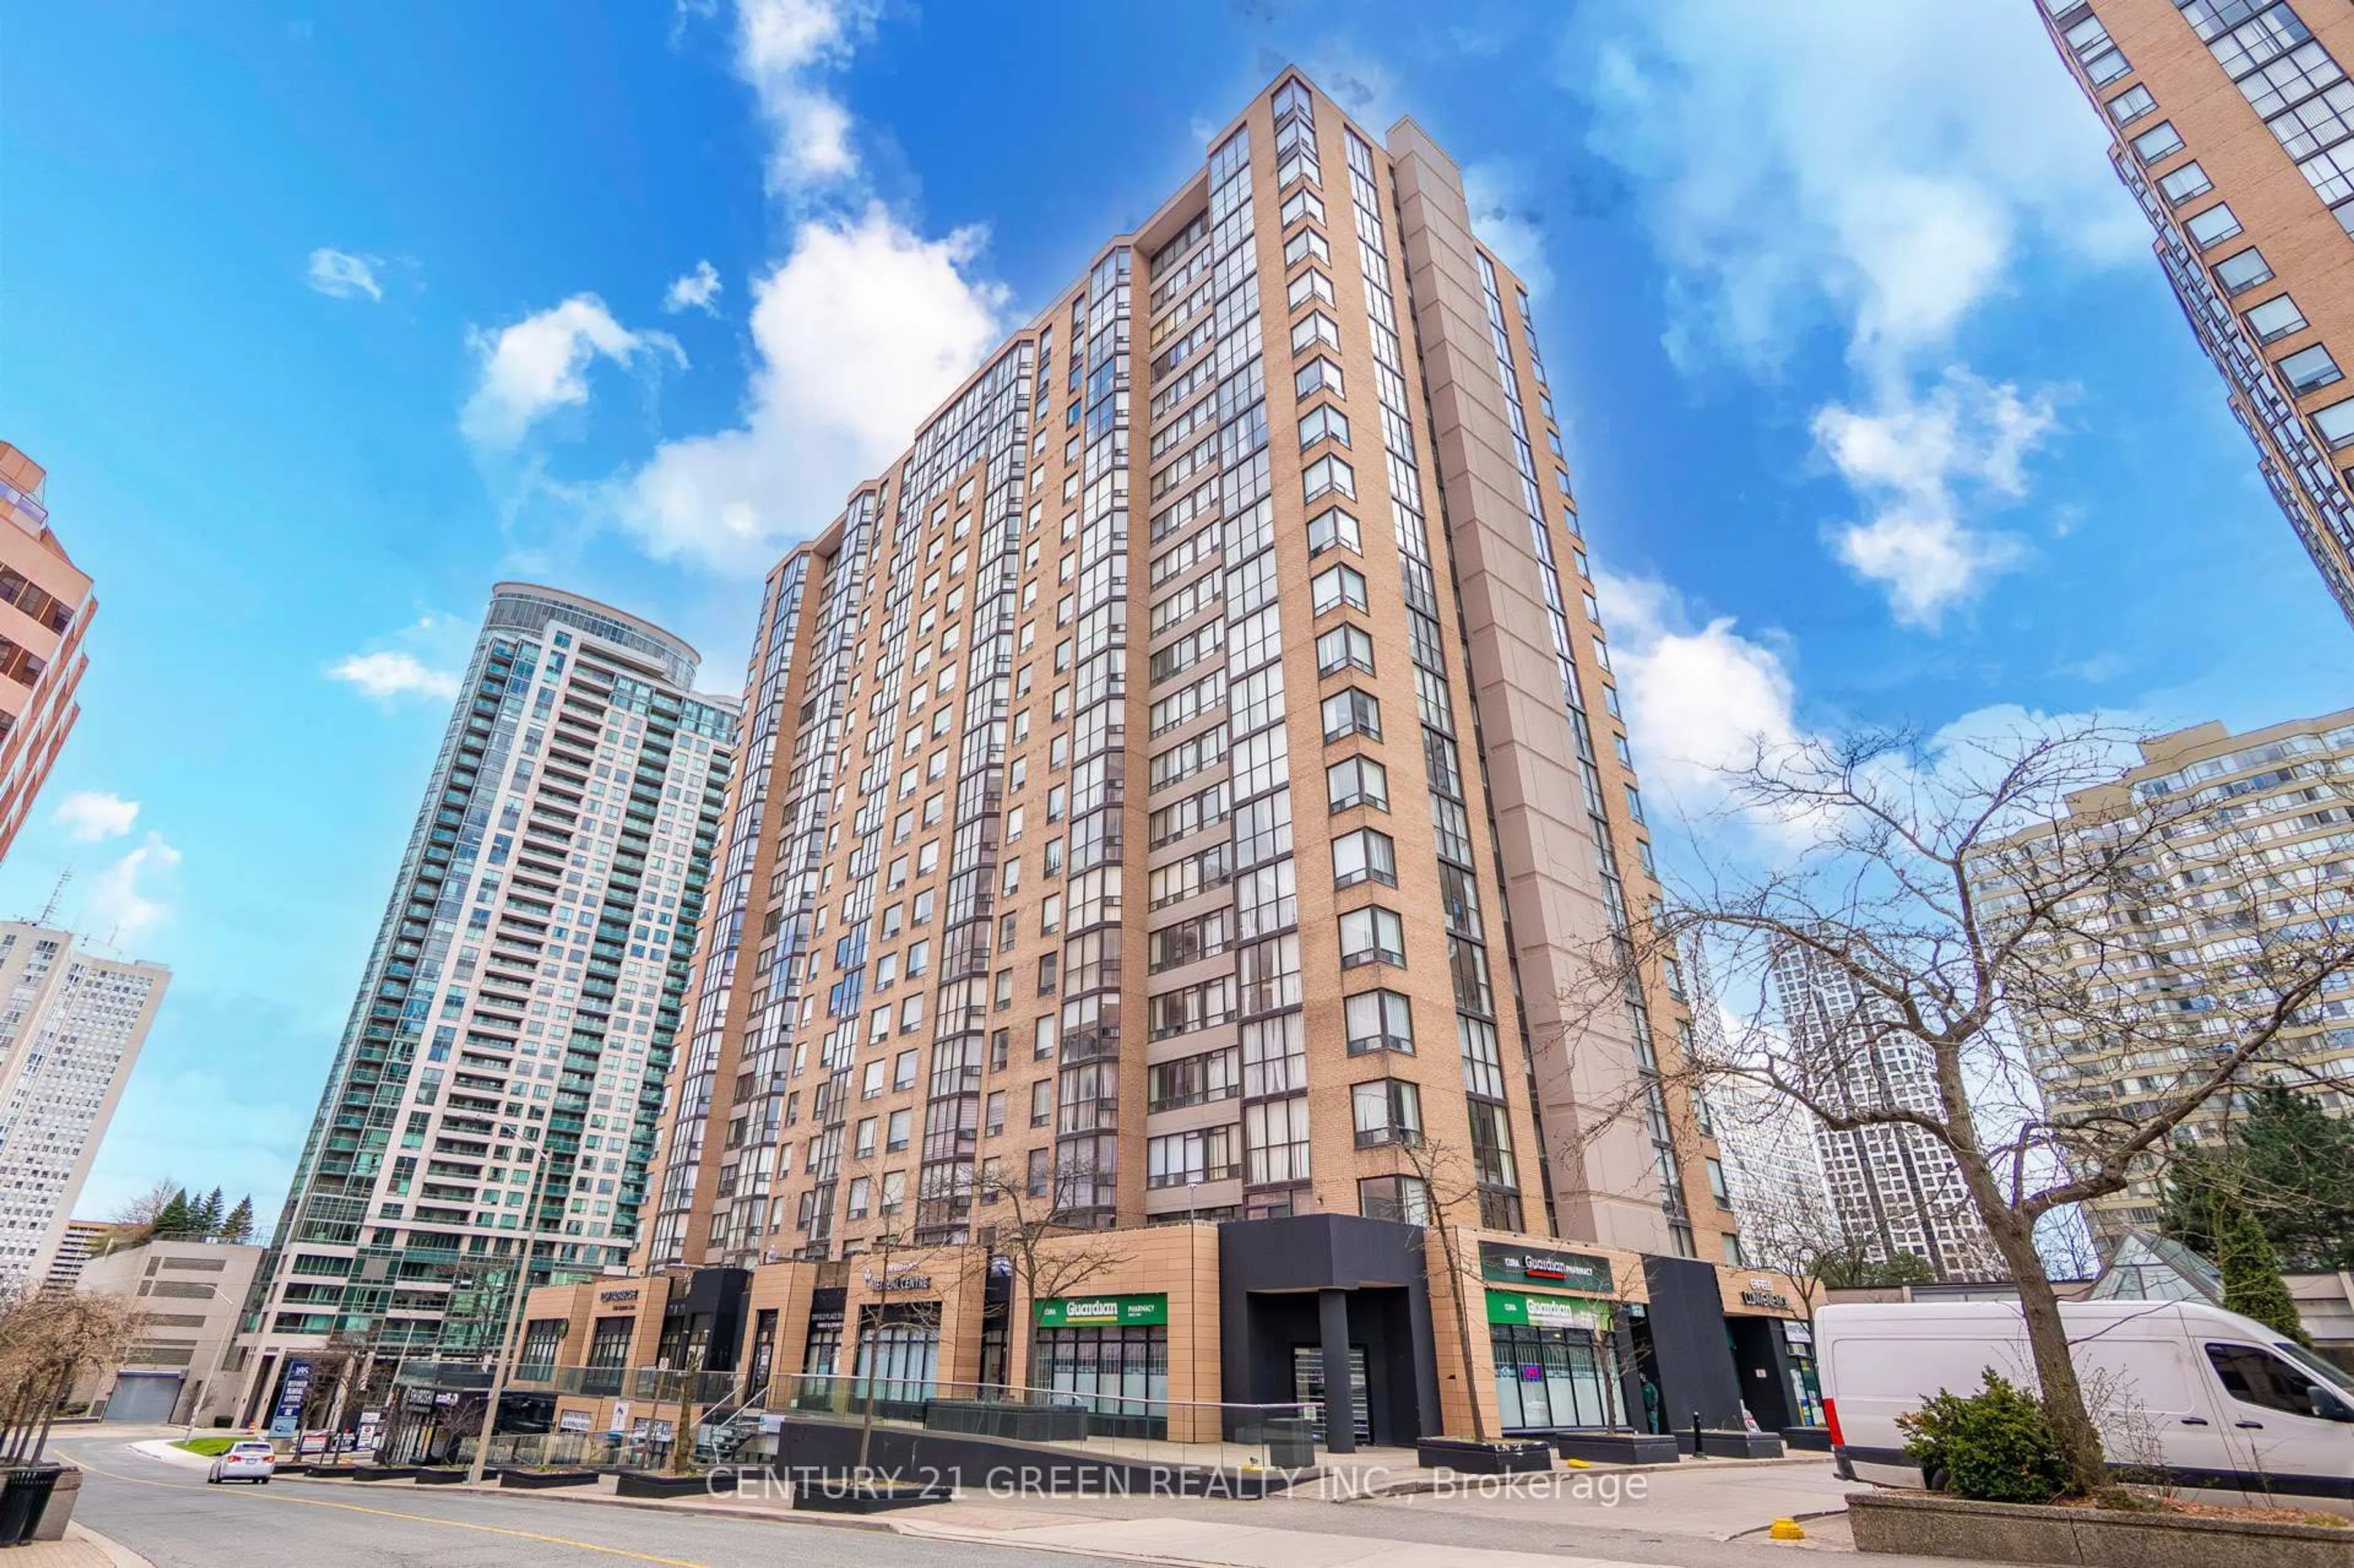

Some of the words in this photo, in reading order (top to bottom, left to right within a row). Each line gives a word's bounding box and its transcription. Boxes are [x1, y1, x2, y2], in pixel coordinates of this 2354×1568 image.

[1525, 1255, 1565, 1273] Guardian
[1066, 1301, 1118, 1316] Guardian
[1526, 1298, 1572, 1317] Guardian
